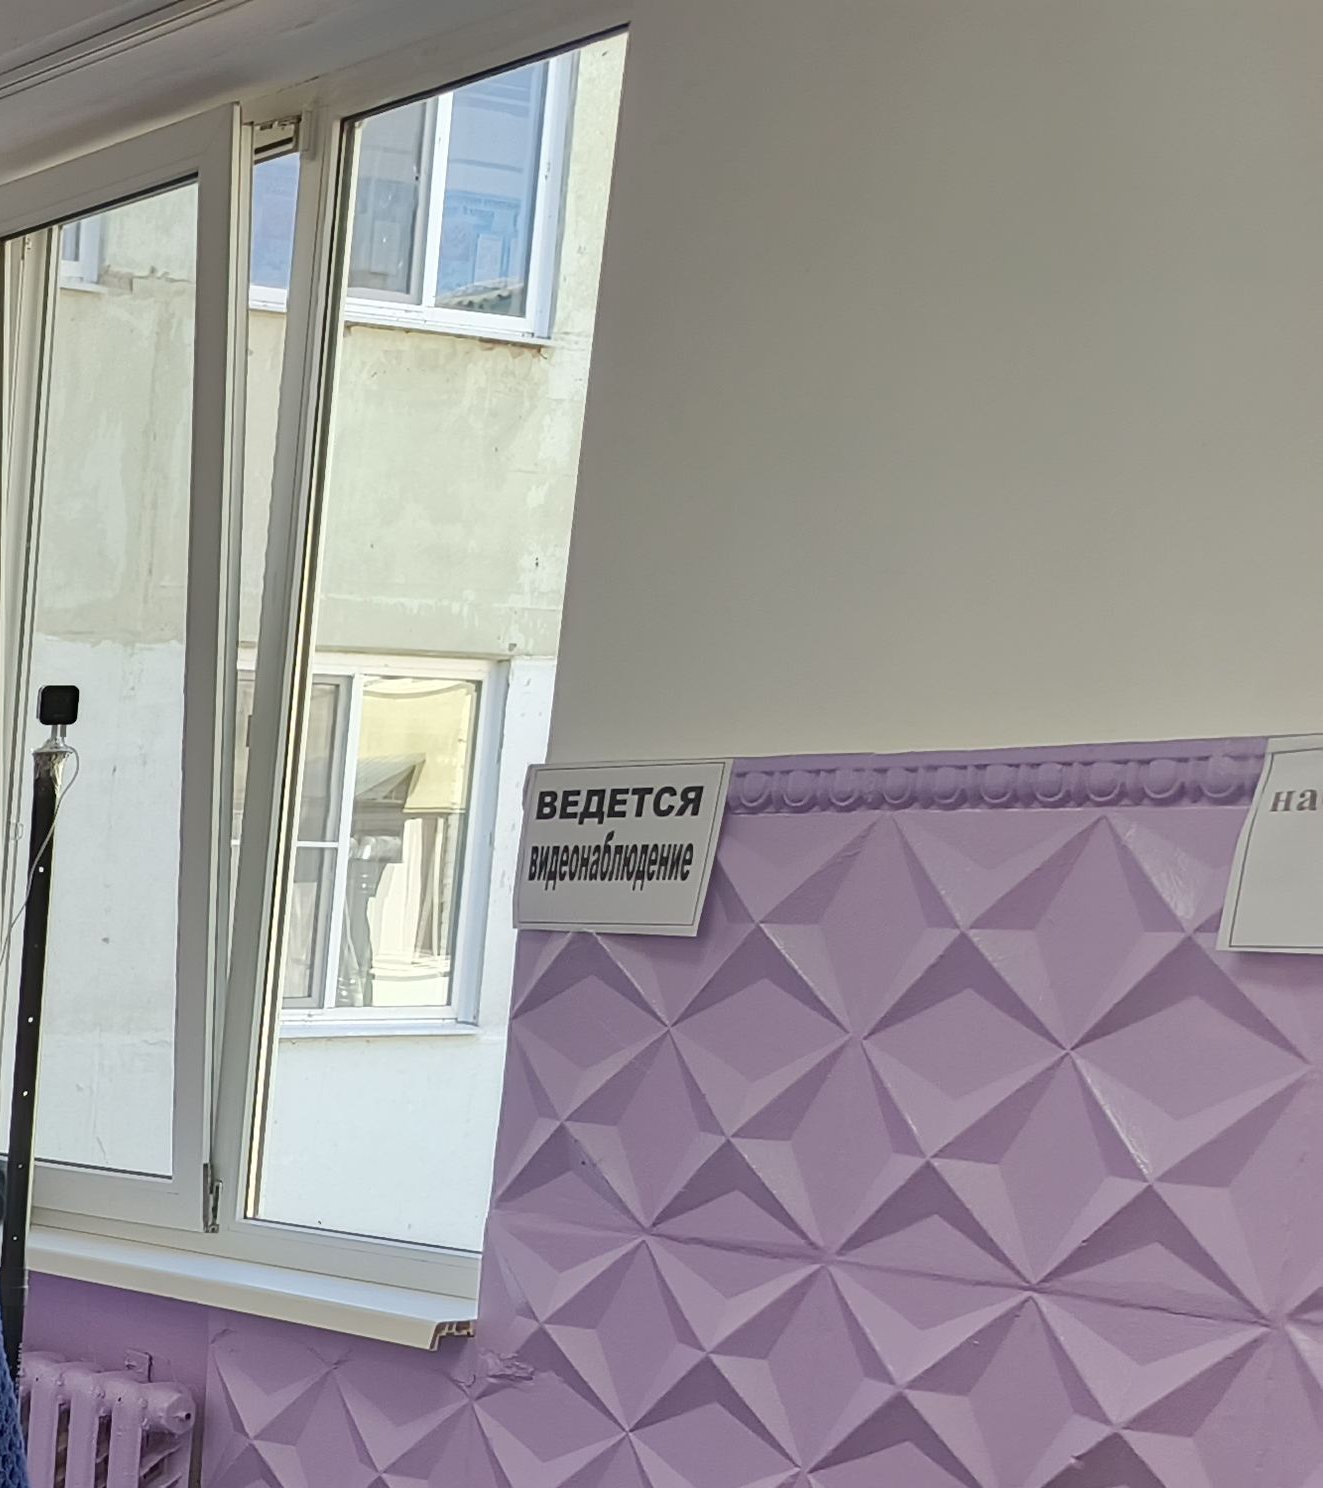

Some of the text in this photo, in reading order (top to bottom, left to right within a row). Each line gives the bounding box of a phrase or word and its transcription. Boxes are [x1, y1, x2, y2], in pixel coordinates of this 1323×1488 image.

[535, 786, 704, 825] ВЕДЕТСЯ
[1269, 788, 1323, 812] на
[528, 830, 694, 891] видеонаблюдение
